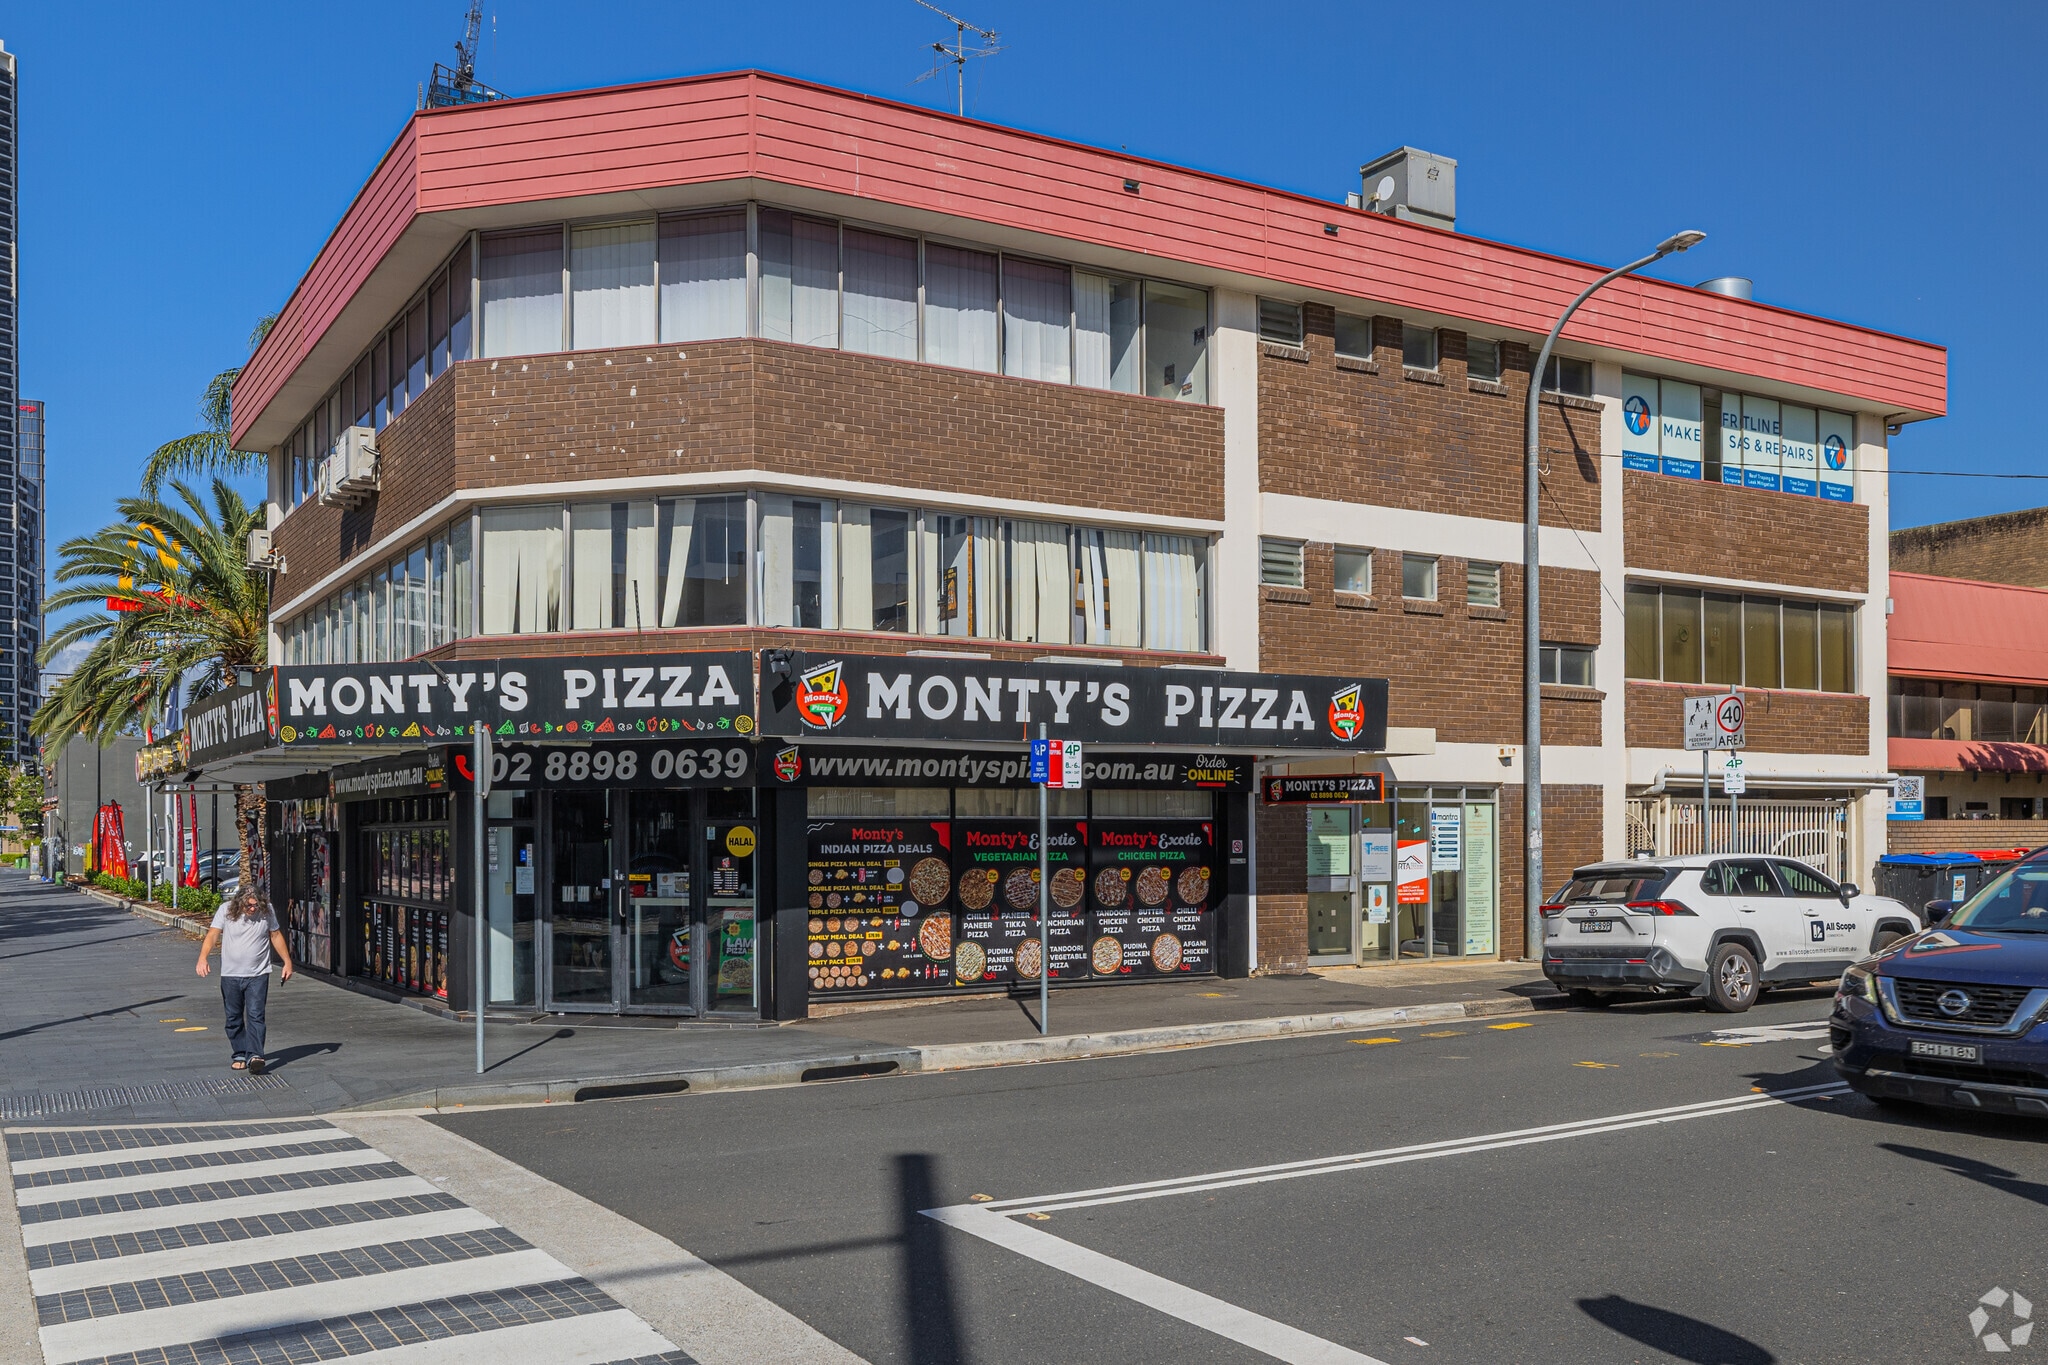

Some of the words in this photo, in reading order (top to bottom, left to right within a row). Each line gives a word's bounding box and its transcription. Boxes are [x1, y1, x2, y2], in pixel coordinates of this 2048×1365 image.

[1663, 423, 1701, 442] MAKE
[1755, 439, 1763, 452] &
[1765, 441, 1814, 462] REPAIRS
[1680, 461, 1695, 469] Damage
[288, 672, 528, 716] MONTY'S
[563, 664, 740, 709] PIZZA
[803, 693, 842, 705] Monty's
[866, 671, 1131, 727] MONTY'S
[1164, 684, 1316, 730] PIZZA
[1333, 711, 1360, 721] Monty's
[1721, 705, 1742, 723] 40
[190, 704, 228, 752] MONTY'S
[231, 690, 265, 739] PIZZA
[1718, 734, 1745, 746] AREA
[1065, 744, 1081, 756] 4P
[491, 752, 532, 783] 02
[544, 750, 638, 782] 8898
[650, 748, 748, 780] 0639
[1196, 754, 1228, 768] Order
[1725, 759, 1743, 768] 4P
[335, 766, 423, 795] www.montyspizza.com.au
[426, 768, 444, 782] ONLINE
[1187, 768, 1235, 781] ONLINE
[1285, 780, 1336, 792] MONTY'S
[1339, 779, 1376, 791] PIZZA
[1436, 812, 1458, 821] mantra
[852, 828, 904, 842] Monty's
[966, 831, 1029, 849] Monty's
[1101, 831, 1158, 849] Monty's
[1158, 832, 1203, 849] Exotic
[728, 837, 754, 846] HALAL
[821, 844, 860, 853] INDIAN
[863, 844, 895, 853] PIZZA
[898, 844, 933, 853] DEALS
[1364, 842, 1389, 855] THREE
[974, 852, 1037, 861] VEGETARIAN
[1047, 852, 1069, 861] IZZA
[1118, 852, 1157, 860] CHICKEN
[1159, 851, 1186, 860] PIZZA
[1398, 862, 1411, 870] RTA
[1096, 909, 1131, 917] TANDOORI
[1172, 915, 1201, 923] CHICKEN
[1036, 919, 1085, 927] MNCHURIAN
[1826, 922, 1835, 931] All
[1835, 922, 1856, 932] Scope
[1103, 926, 1123, 934] PIZZA
[726, 947, 747, 955] PIZZA
